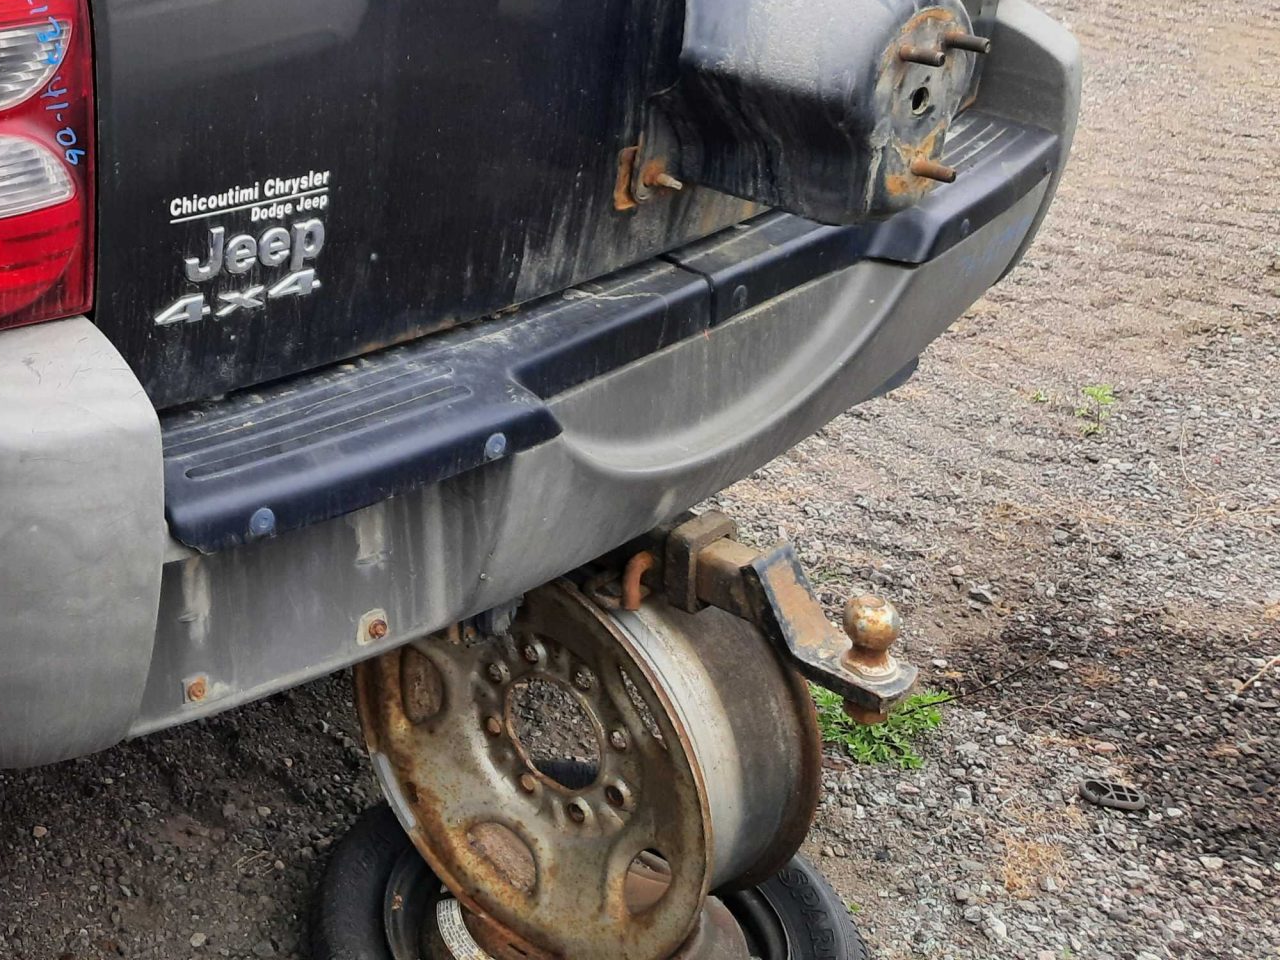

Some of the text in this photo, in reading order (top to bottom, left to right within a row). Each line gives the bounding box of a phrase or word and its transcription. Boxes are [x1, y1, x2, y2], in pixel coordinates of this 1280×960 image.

[169, 169, 331, 217] Chicoutimi Chrysler
[250, 193, 329, 223] Dodge Jeep
[184, 218, 325, 283] Jeep
